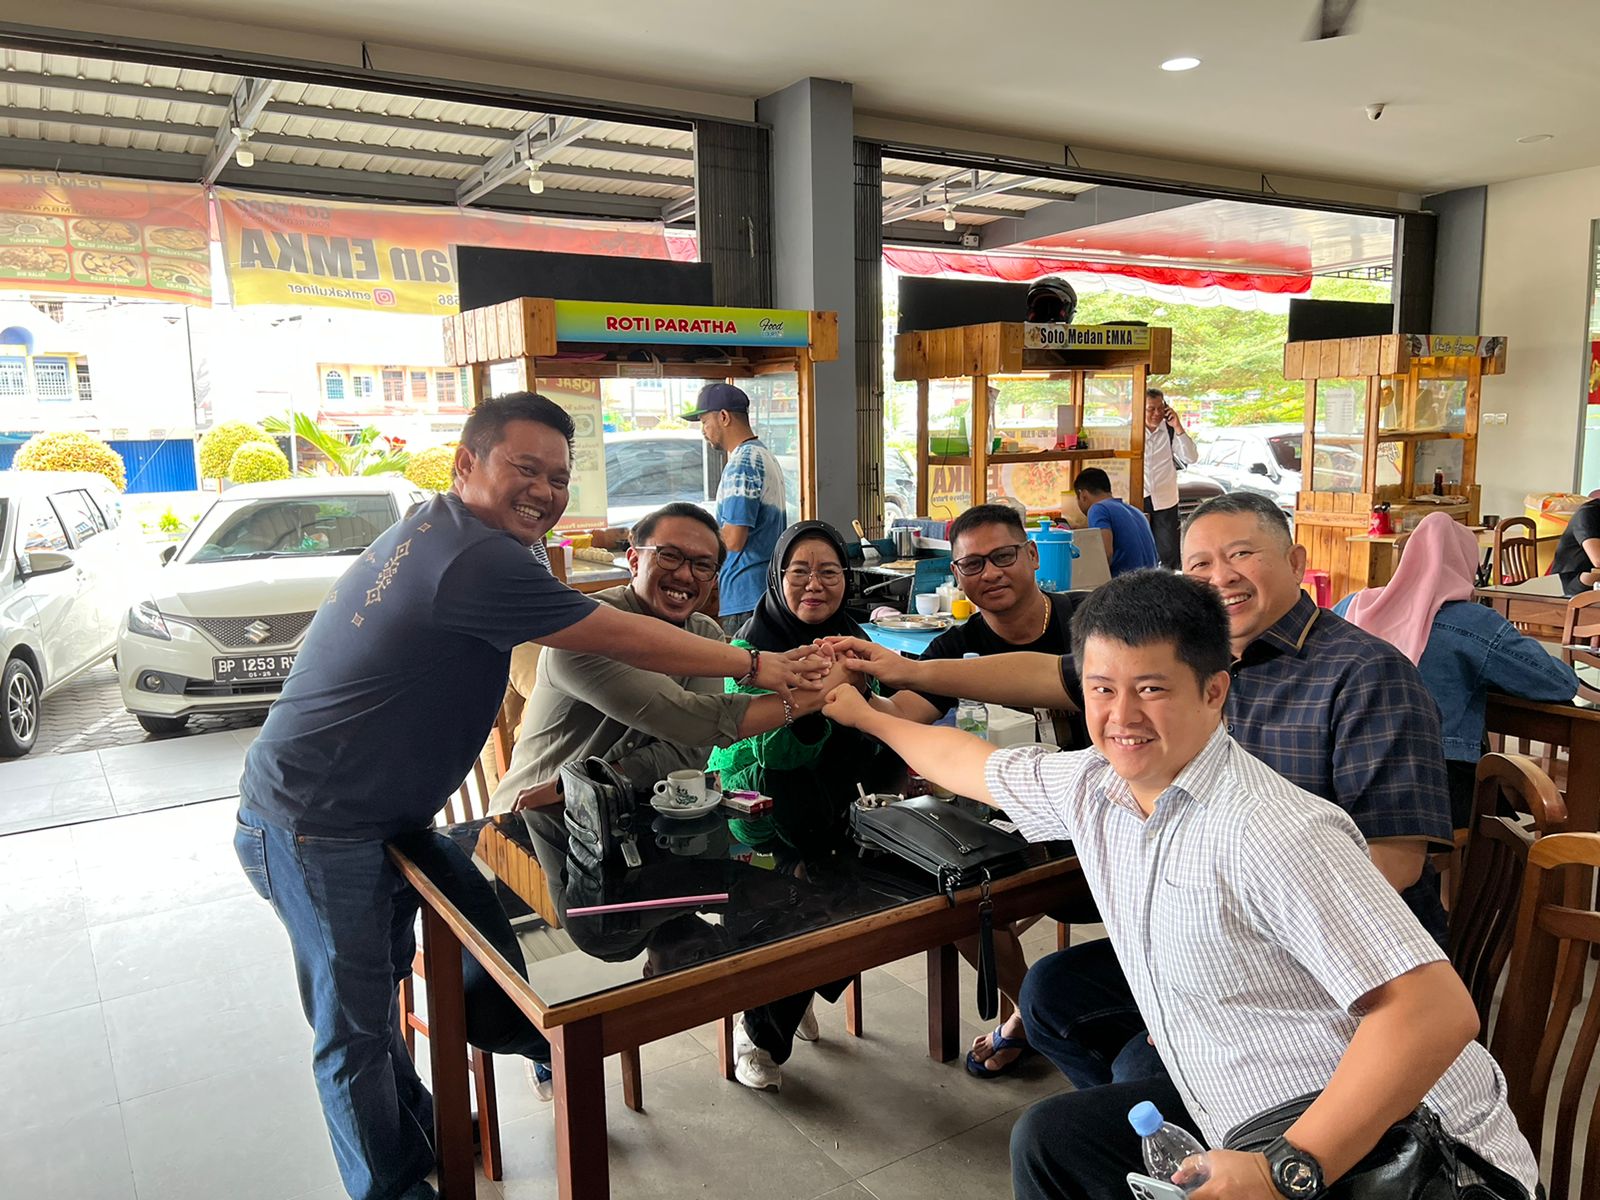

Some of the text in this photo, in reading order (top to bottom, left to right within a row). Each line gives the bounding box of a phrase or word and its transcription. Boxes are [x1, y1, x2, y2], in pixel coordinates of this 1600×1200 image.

[606, 316, 737, 334] ROTI PARATHA
[759, 317, 784, 331] Food
[1040, 327, 1065, 344] Soto
[1068, 328, 1103, 345] Medan
[1105, 329, 1133, 345] EMKA
[218, 660, 235, 673] BP
[242, 657, 275, 671] 1253
